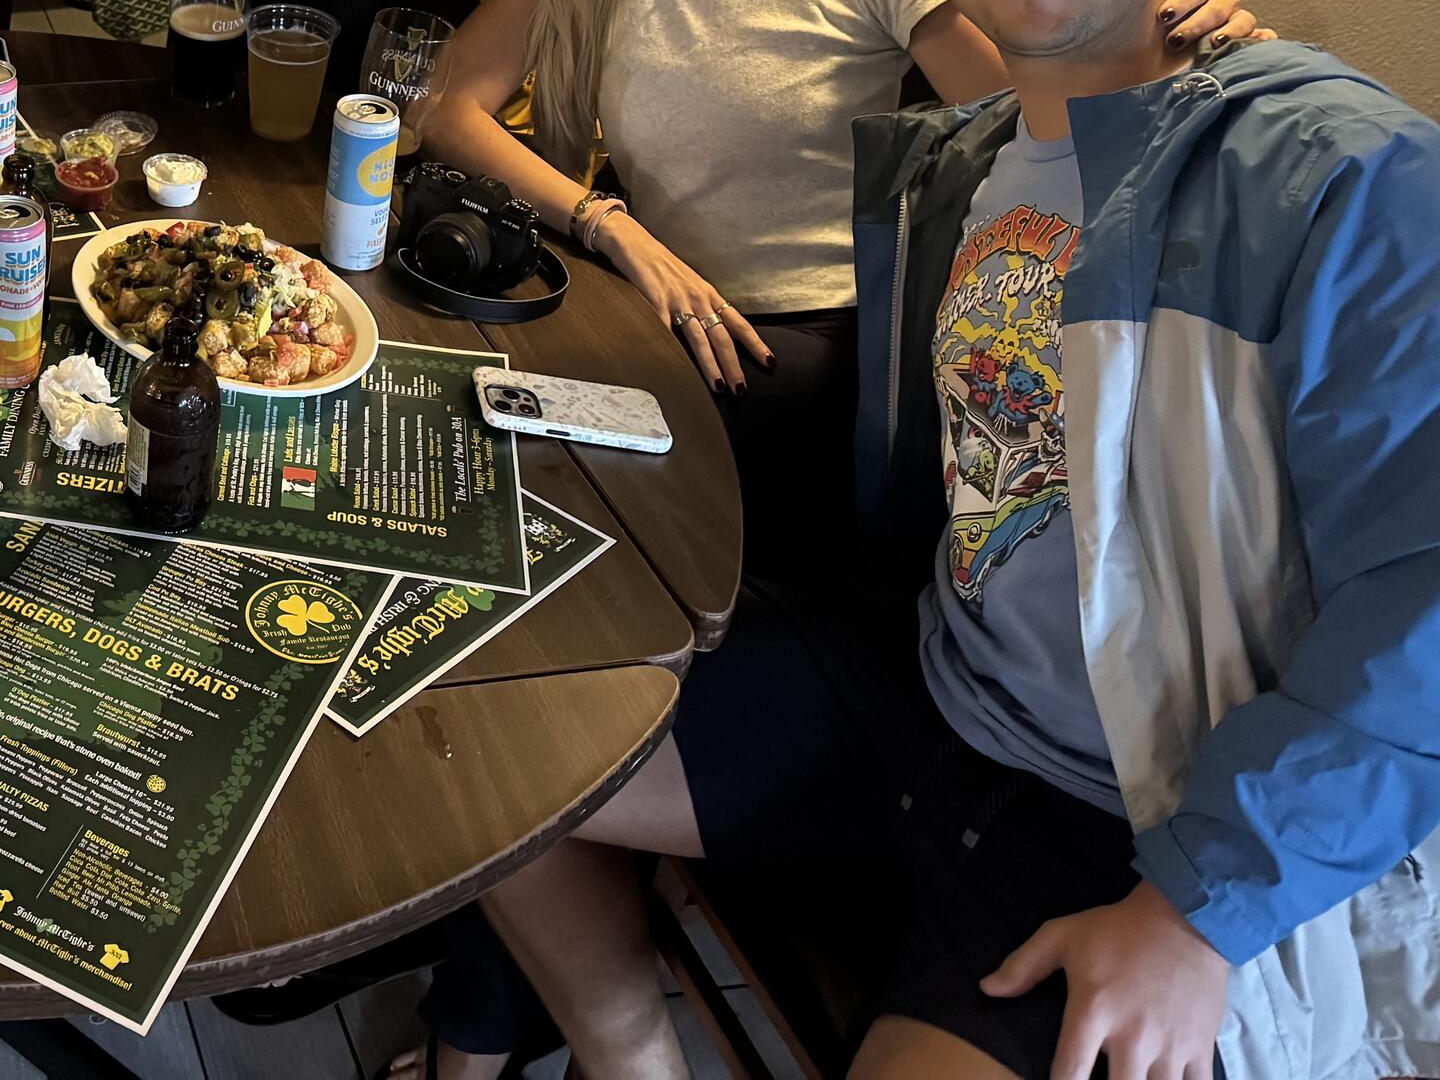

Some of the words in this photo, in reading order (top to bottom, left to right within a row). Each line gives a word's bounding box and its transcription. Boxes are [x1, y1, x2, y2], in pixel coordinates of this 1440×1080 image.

[369, 71, 430, 98] GUINNESS
[461, 198, 489, 214] FUJIFILM
[5, 245, 41, 265] SUN
[995, 262, 1057, 304] TOUR
[6, 390, 25, 422] DINING
[286, 416, 295, 436] Lassies
[451, 417, 462, 431] 30A
[285, 435, 294, 447] and
[455, 433, 463, 442] on
[471, 429, 481, 450] 3-6pm
[283, 448, 293, 462] Lads
[452, 443, 464, 458] Pub
[472, 451, 482, 469] Hour
[483, 438, 493, 461] Saturday
[19, 461, 35, 485] GUINNESS
[453, 458, 465, 485] Locals'
[474, 471, 485, 494] Happy
[484, 467, 496, 490] Monday
[454, 487, 466, 501] The
[327, 510, 369, 527] SOUP
[373, 517, 384, 529] &
[387, 519, 448, 538] SALADS
[5, 521, 46, 552] SAN
[254, 591, 281, 628] Johnny
[283, 584, 354, 620] McTighe's
[404, 591, 420, 605] &
[377, 600, 409, 626] IRISH
[332, 624, 351, 633] Pub
[357, 590, 469, 675] McTighe's
[83, 628, 142, 660] DOGS
[145, 654, 161, 670] &
[167, 662, 238, 699] BRATS
[97, 724, 140, 747] Brautwurst
[0, 735, 19, 747] Fresh
[20, 744, 50, 762] Toppings
[51, 758, 78, 776] (Fillers)
[6, 715, 33, 729] original
[32, 726, 55, 739] recipe
[55, 735, 75, 749] that's
[75, 746, 96, 759] stone
[96, 755, 115, 768] oven
[114, 763, 142, 780] baked!
[92, 731, 114, 744] Served
[113, 741, 127, 750] with
[127, 748, 160, 766] sauerkraut.
[20, 793, 49, 811] PIZZAS
[84, 774, 99, 785] Each
[99, 783, 129, 799] additional
[129, 796, 152, 811] topping
[157, 810, 174, 821] $3.00
[95, 771, 112, 783] Large
[113, 779, 134, 793] Cheese
[153, 800, 174, 812] $21.99
[85, 830, 129, 857] Beverages
[72, 848, 112, 871] Non-Alcoholic
[114, 869, 143, 887] Beverages
[150, 887, 168, 899] $4.00
[14, 906, 50, 931] Johnny
[46, 921, 94, 951] McTighe's
[14, 928, 36, 942] about
[36, 939, 79, 964] McTighe's
[80, 961, 132, 990] merchandise!
